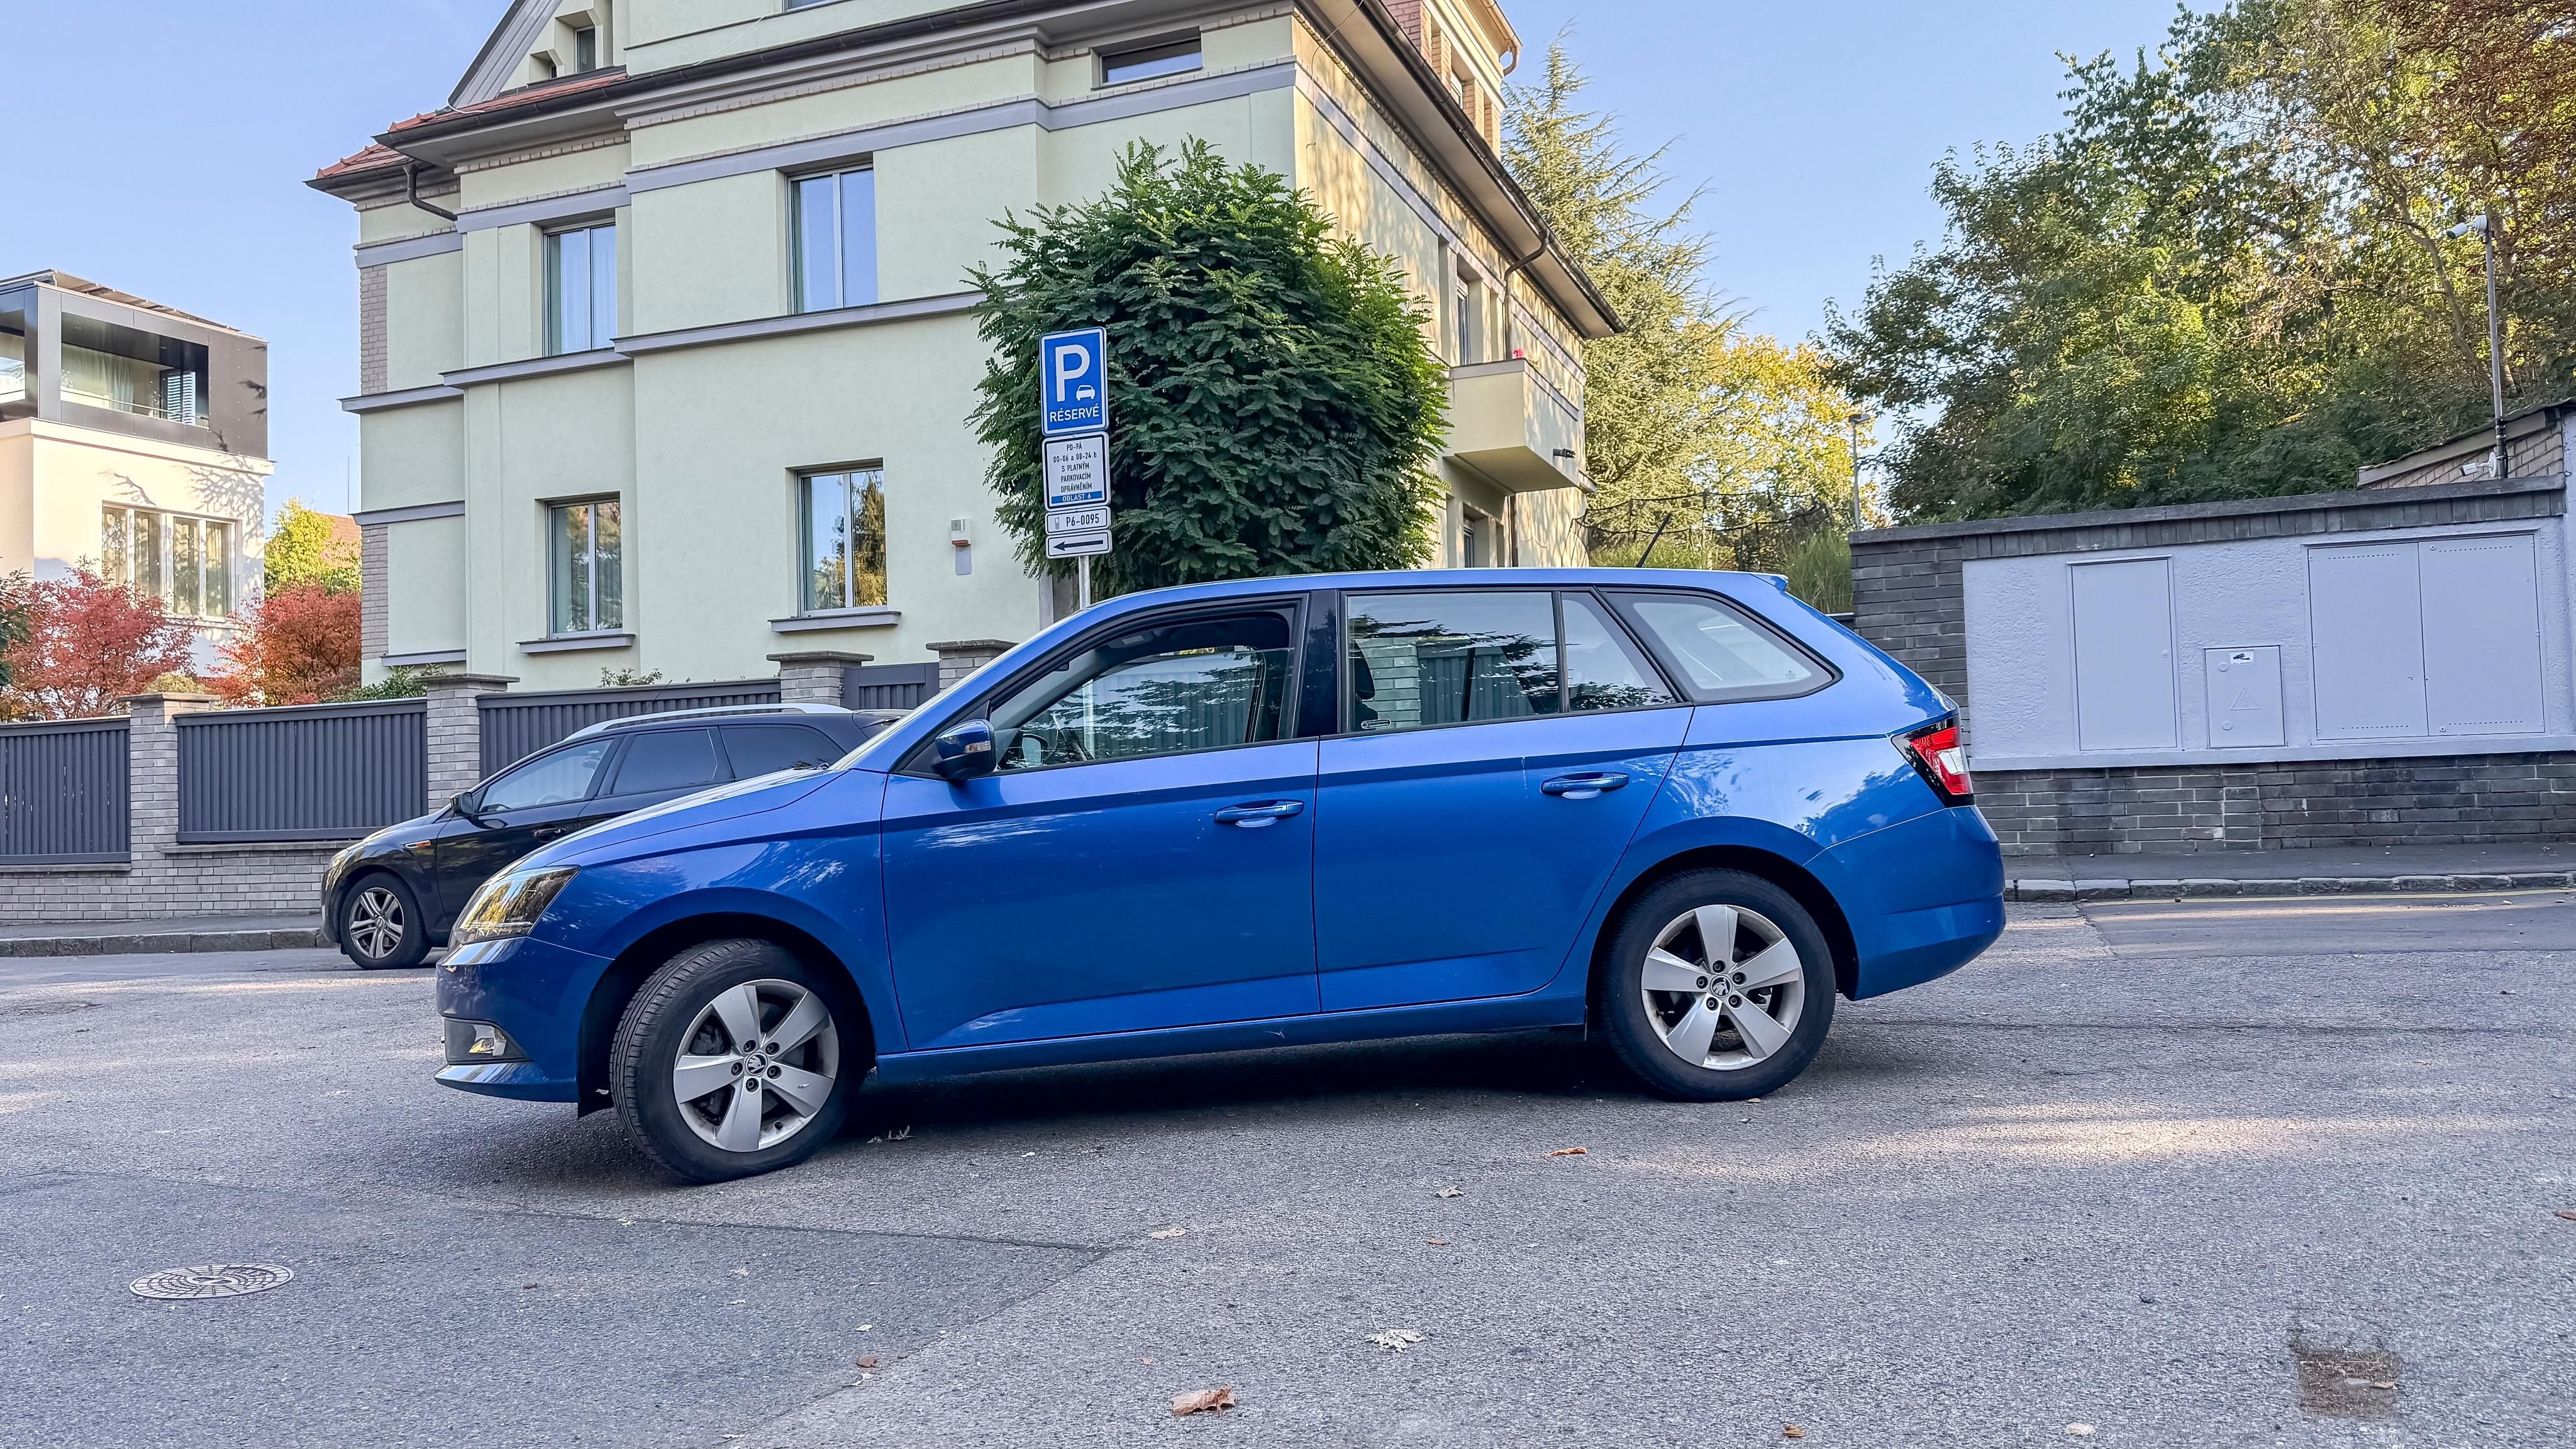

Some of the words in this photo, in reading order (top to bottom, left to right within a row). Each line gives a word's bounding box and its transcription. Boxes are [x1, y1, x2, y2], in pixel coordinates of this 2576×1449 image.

[1055, 344, 1090, 402] P
[1050, 403, 1099, 423] RÉSERVÉ
[1067, 441, 1082, 451] PO-PÁ
[1067, 461, 1089, 472] PLATNÝM
[1061, 472, 1091, 483] PARKOVACÍM
[1062, 494, 1085, 502] OBLAST
[1067, 513, 1099, 527] P6-0095
